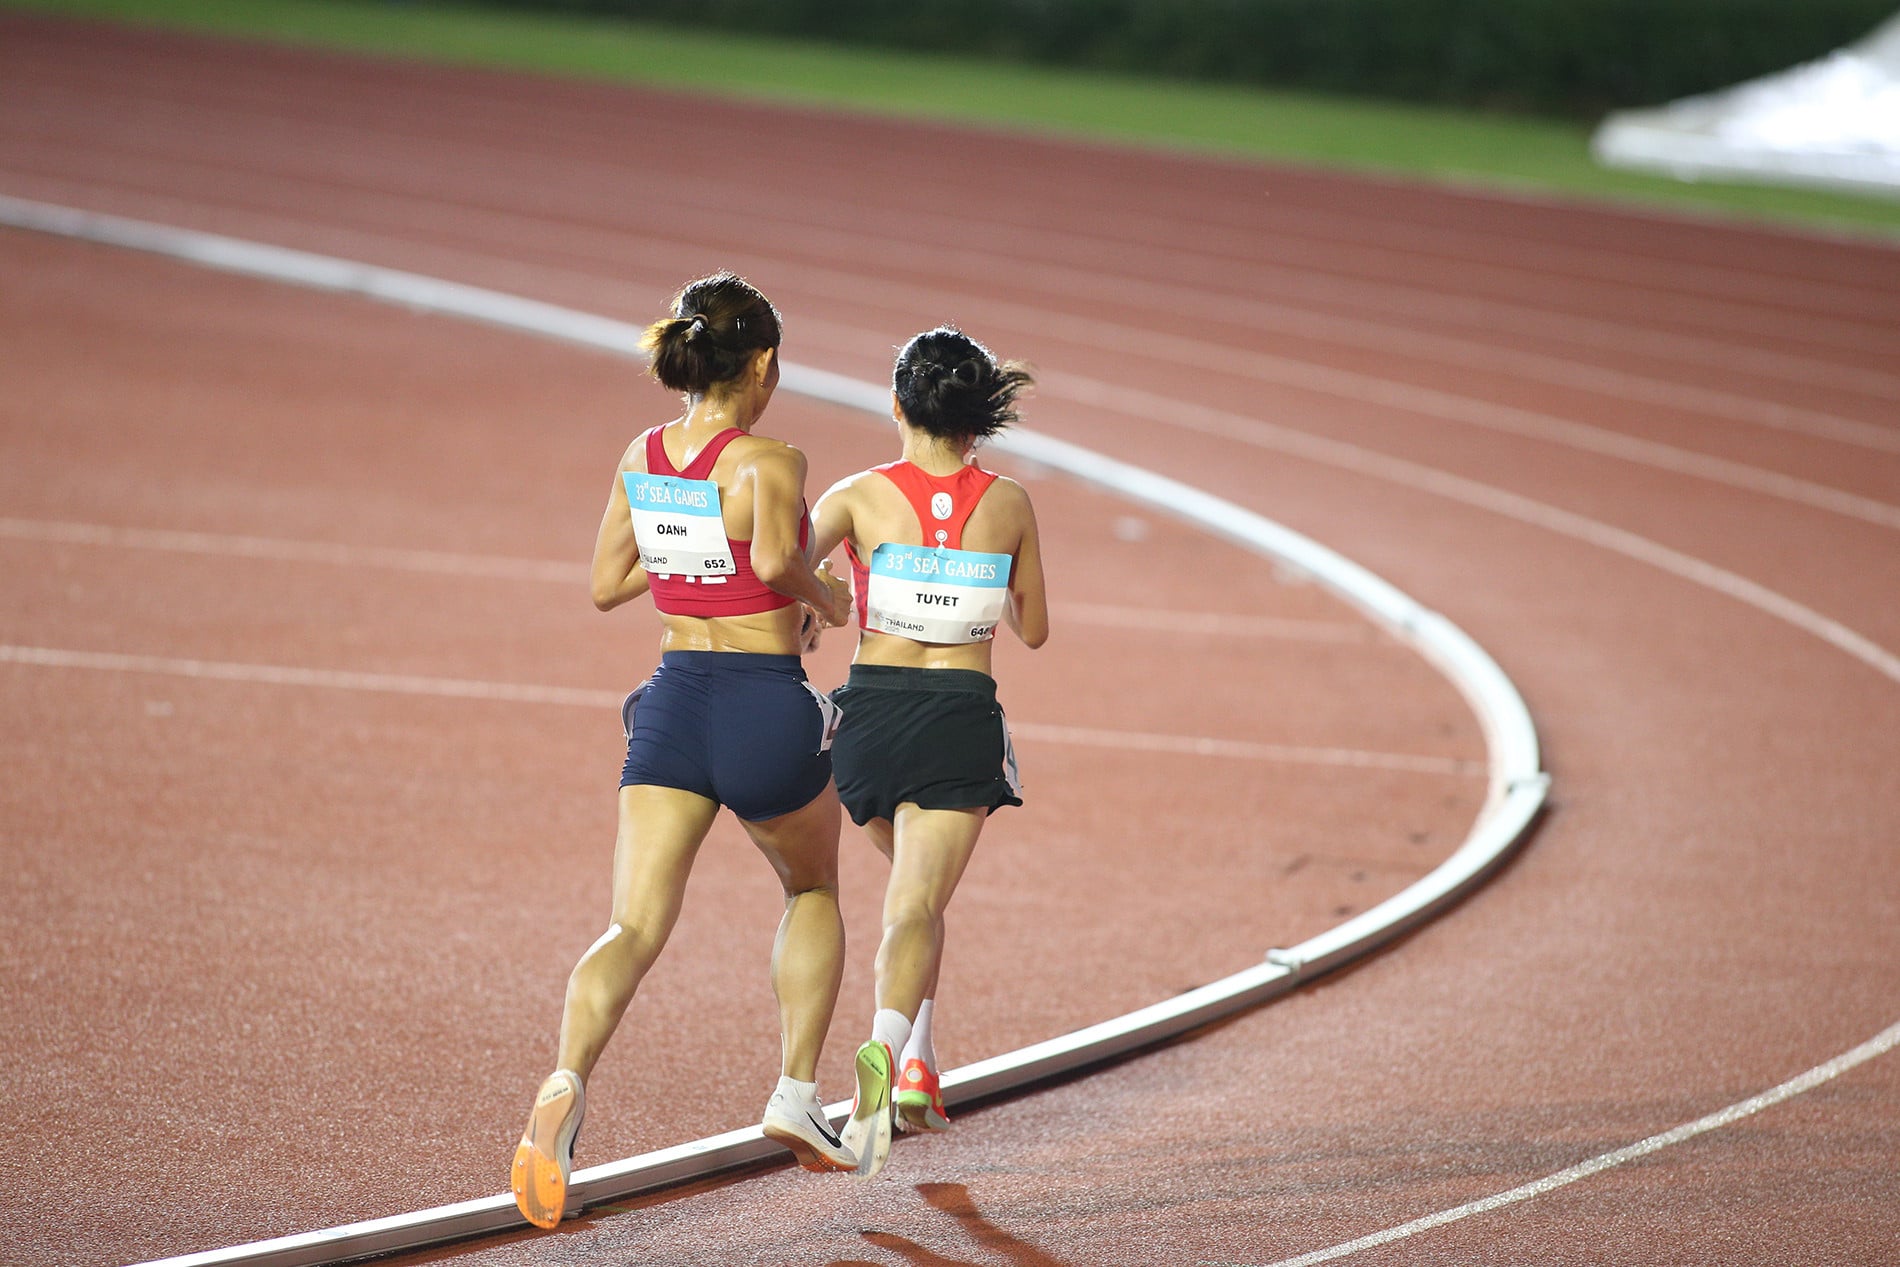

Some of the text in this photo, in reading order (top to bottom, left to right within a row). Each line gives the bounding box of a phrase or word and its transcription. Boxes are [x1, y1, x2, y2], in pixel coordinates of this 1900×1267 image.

[649, 487, 672, 504] SEA
[674, 488, 708, 508] GAMES
[657, 524, 687, 537] OANH
[704, 559, 727, 569] 652
[886, 551, 996, 580] 33rd SEA GAMES
[916, 593, 960, 607] TUYET
[885, 617, 925, 632] THAILAND
